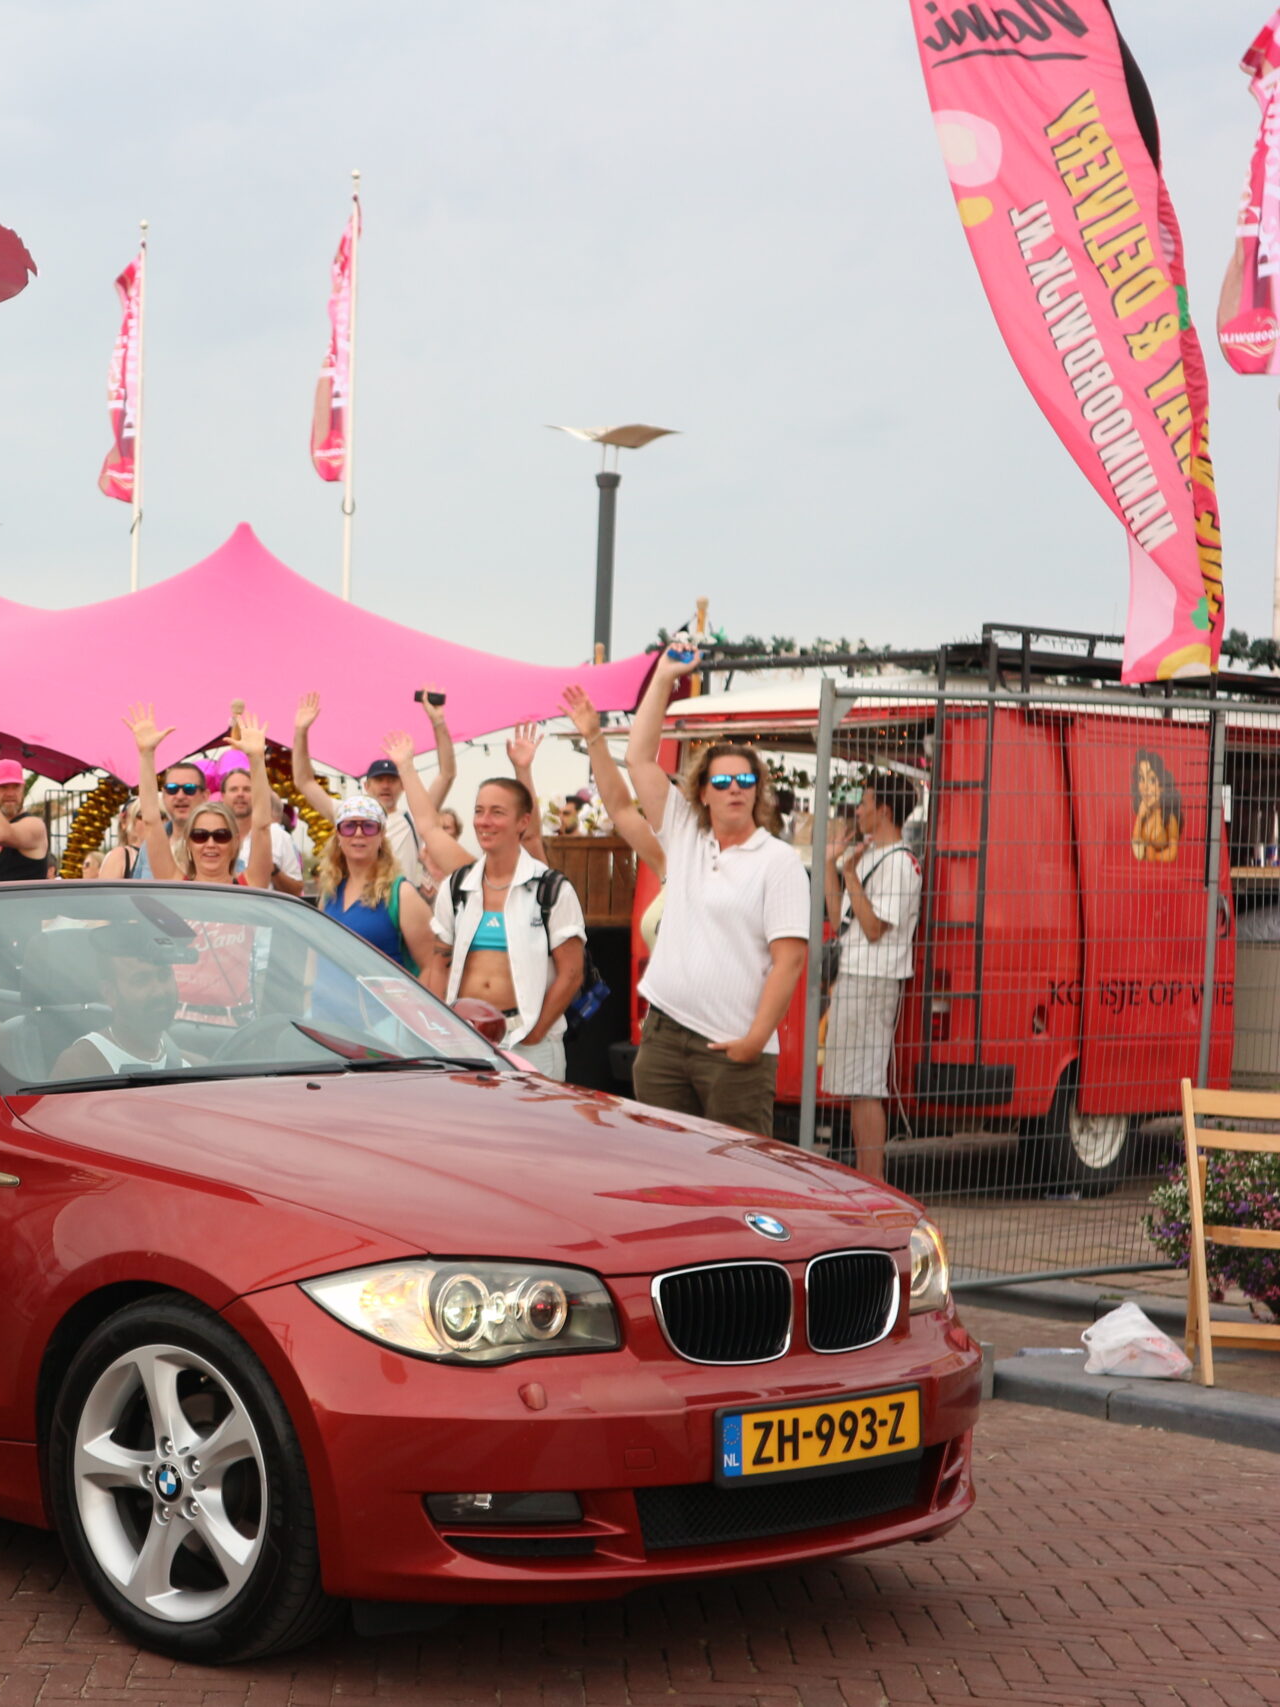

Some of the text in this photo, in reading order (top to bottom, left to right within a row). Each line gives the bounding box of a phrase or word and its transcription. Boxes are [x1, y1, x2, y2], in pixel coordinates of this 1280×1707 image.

[1149, 980, 1182, 1006] OP
[752, 1402, 905, 1466] ZH-993-Z
[724, 1453, 740, 1468] NL
